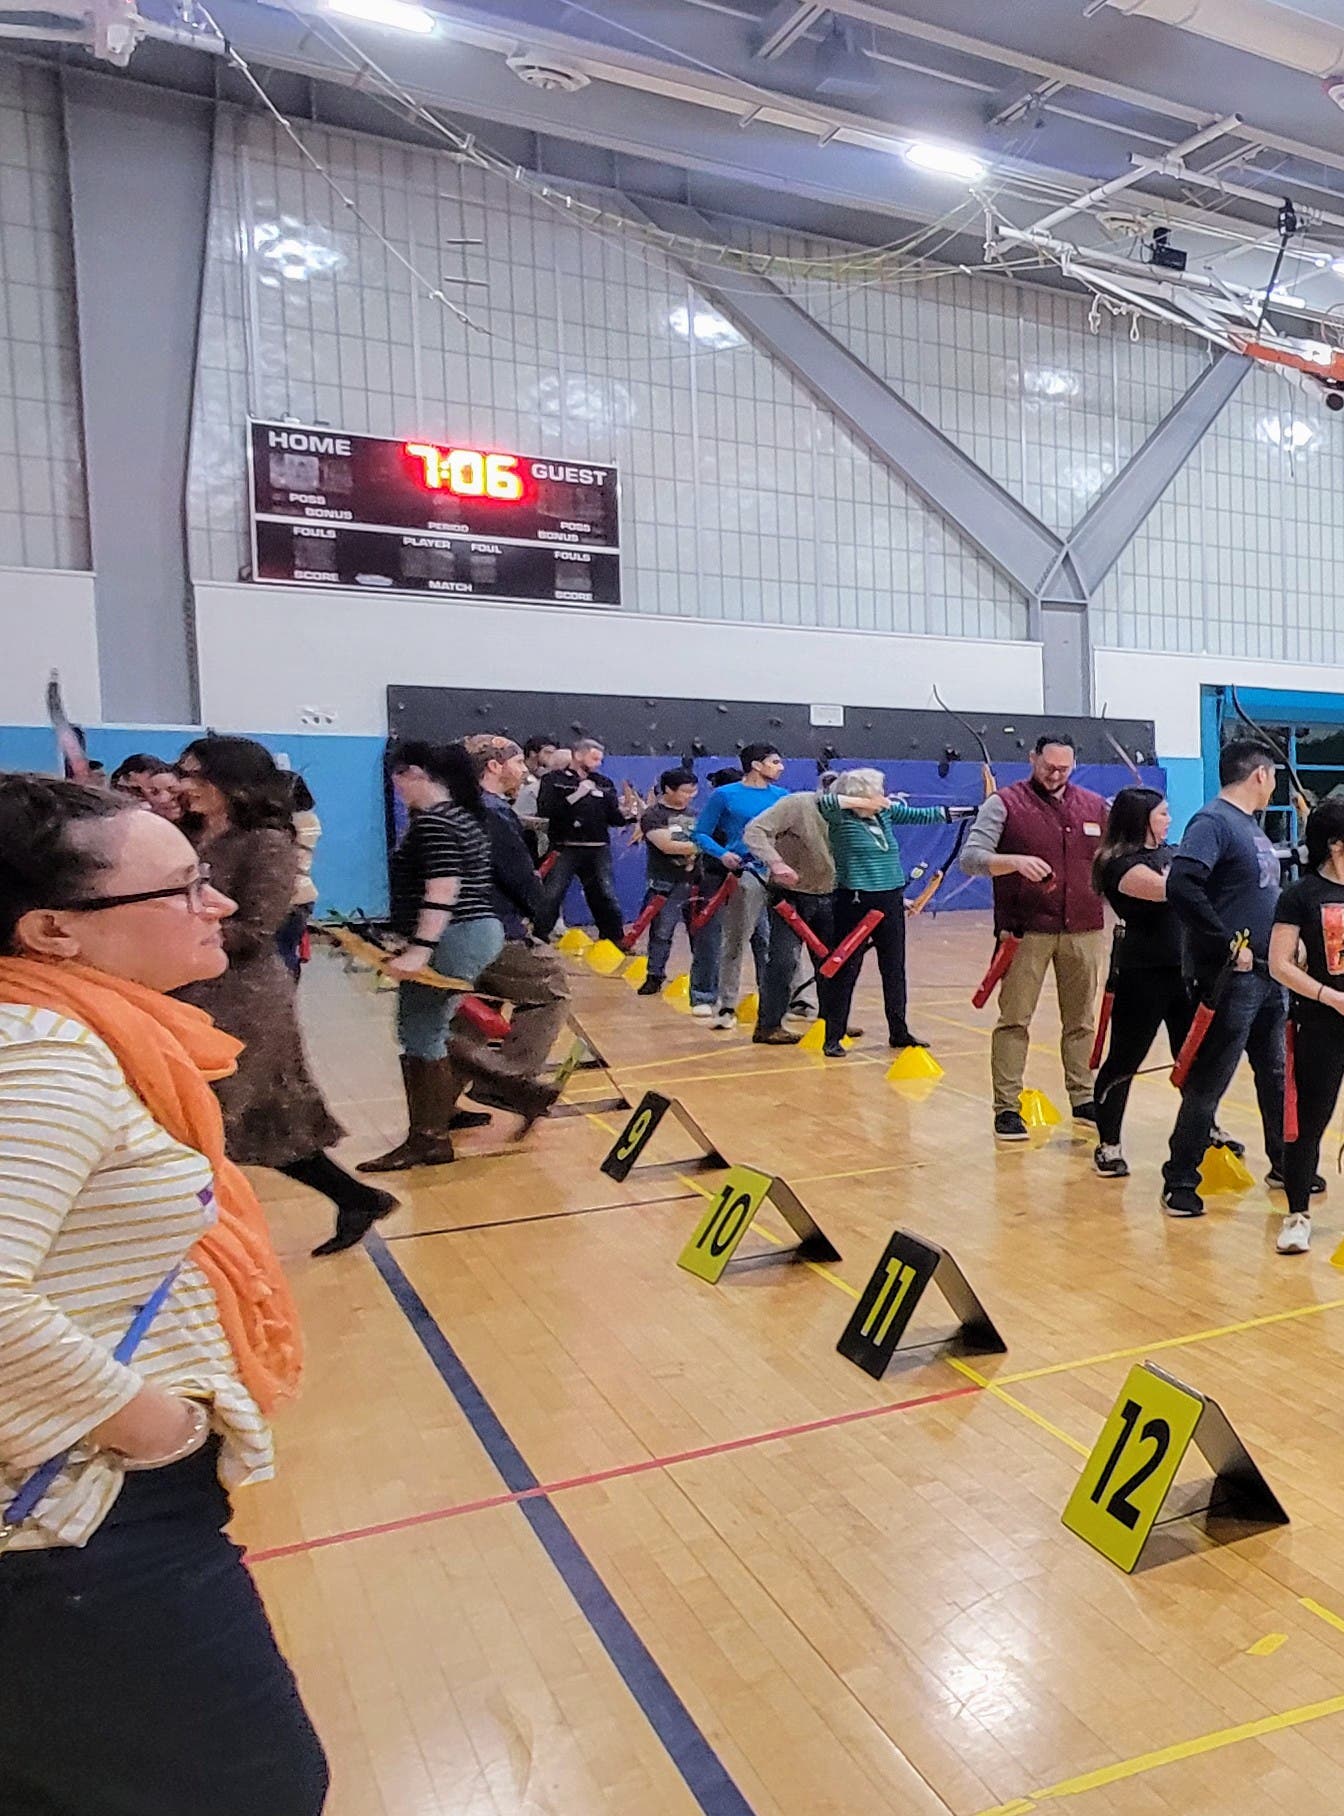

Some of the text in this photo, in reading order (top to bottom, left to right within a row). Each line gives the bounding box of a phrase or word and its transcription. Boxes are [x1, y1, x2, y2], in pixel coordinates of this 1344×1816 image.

[268, 430, 352, 456] HOME
[407, 444, 523, 499] 7:06
[531, 463, 607, 486] GUEST
[289, 493, 326, 505] POSS
[305, 507, 353, 520] BONUS
[293, 526, 337, 538] FOULS
[428, 522, 470, 533] PERIOD
[538, 530, 579, 542] BONUS
[403, 537, 451, 549] PLAYER
[471, 543, 502, 554] FOUL
[554, 551, 591, 562] FOULS
[294, 570, 339, 582] SCORE
[428, 581, 472, 592] MATCH
[554, 590, 593, 601] SCORE
[617, 1109, 652, 1160] 9
[696, 1185, 751, 1257] 10
[860, 1257, 916, 1346] 11
[1090, 1399, 1171, 1530] 12
